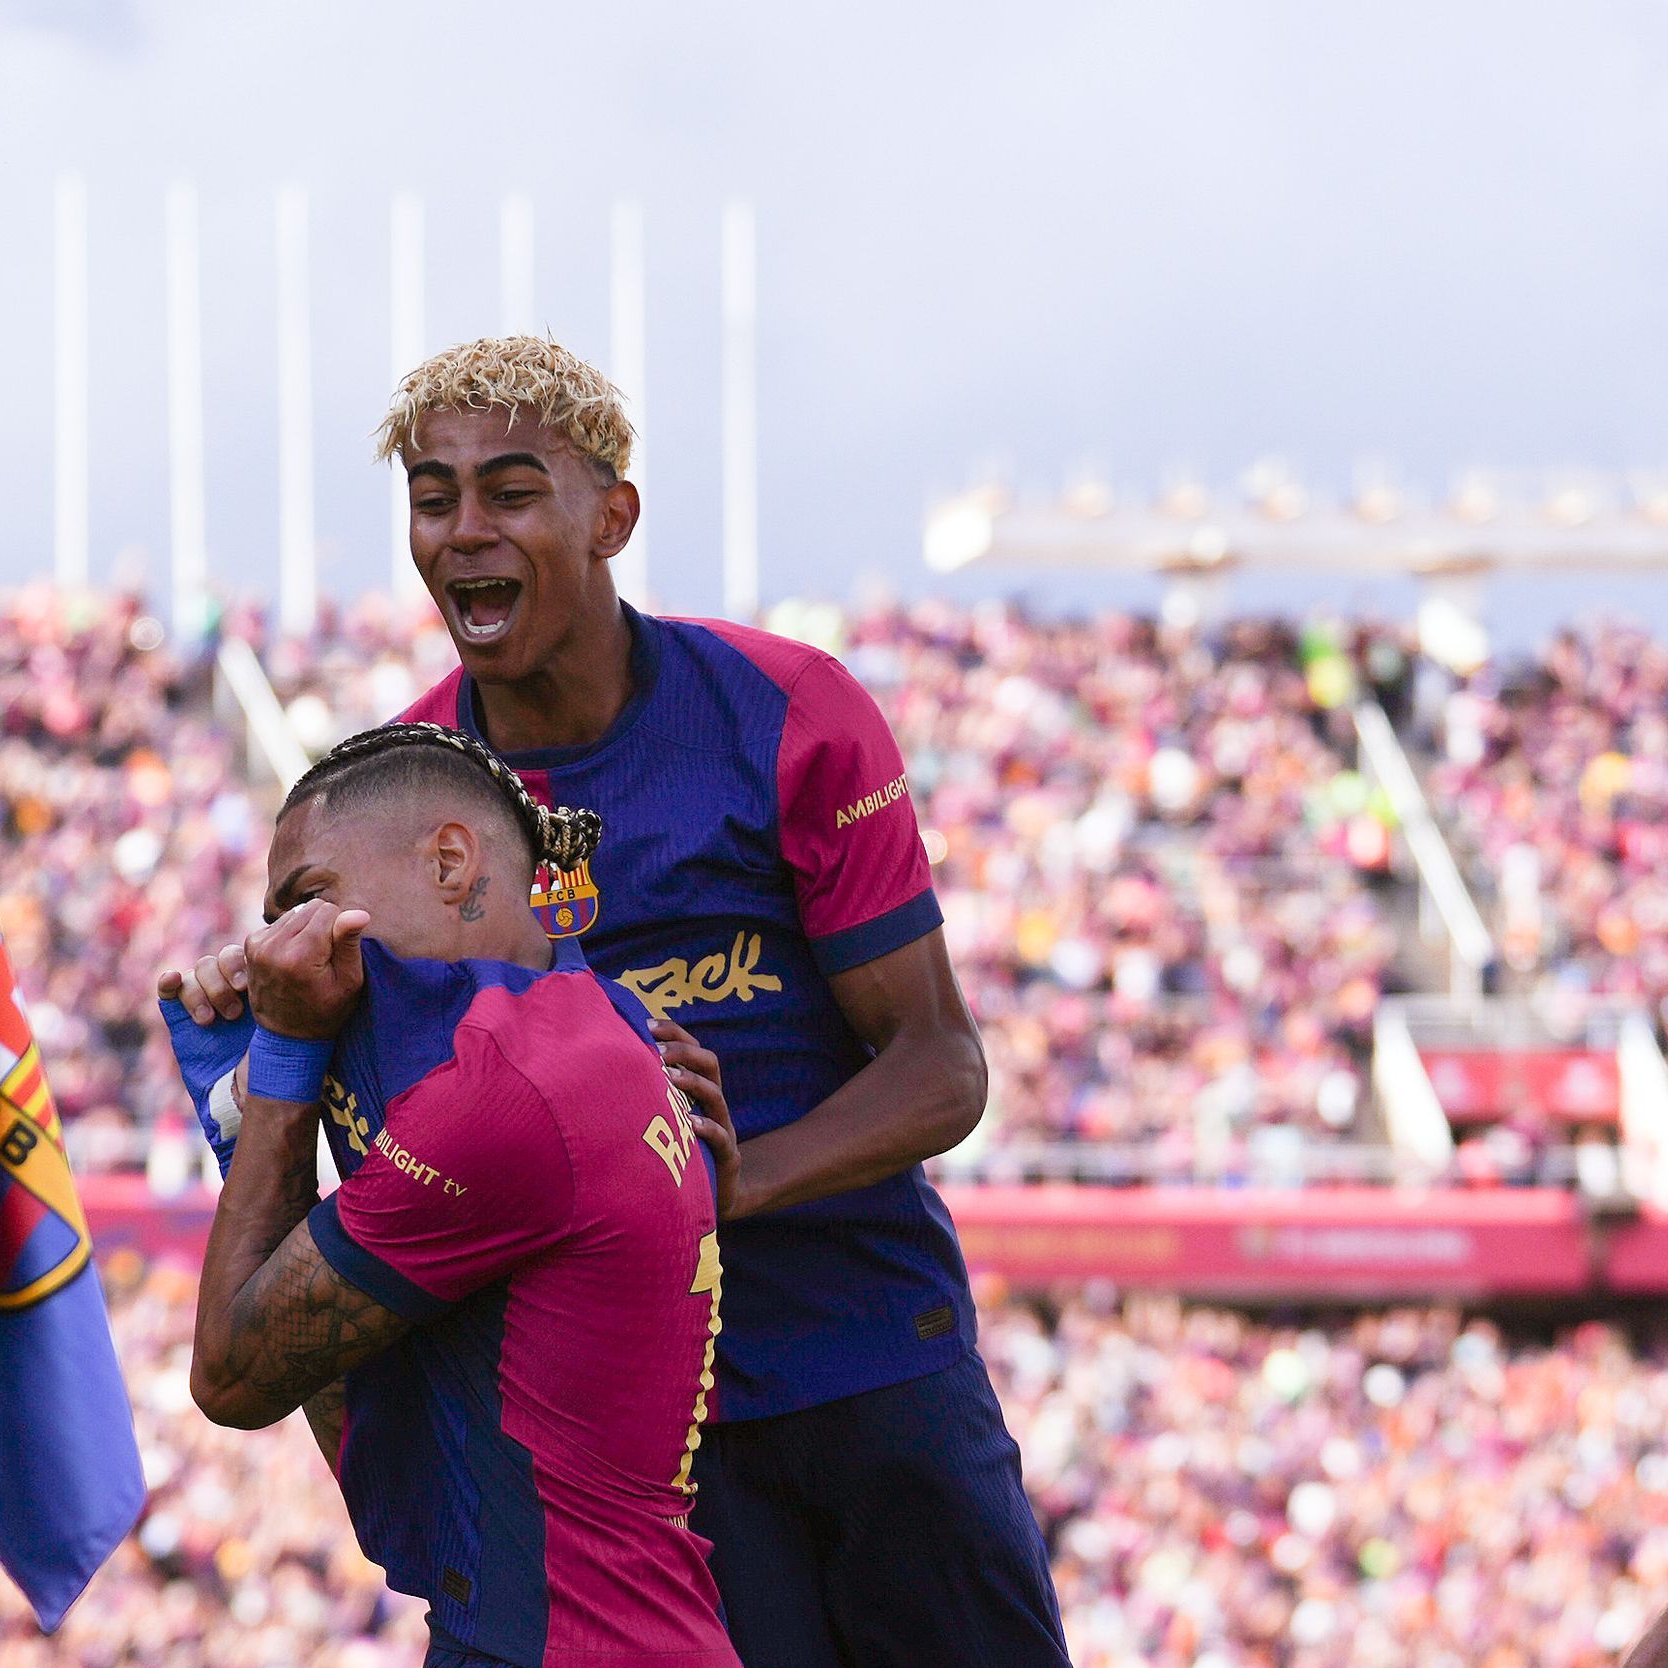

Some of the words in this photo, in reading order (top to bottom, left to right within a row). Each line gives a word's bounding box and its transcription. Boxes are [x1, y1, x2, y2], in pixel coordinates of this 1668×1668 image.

[836, 773, 909, 829] AMBILIGHT
[546, 889, 576, 903] FCB
[443, 1178, 468, 1197] tv
